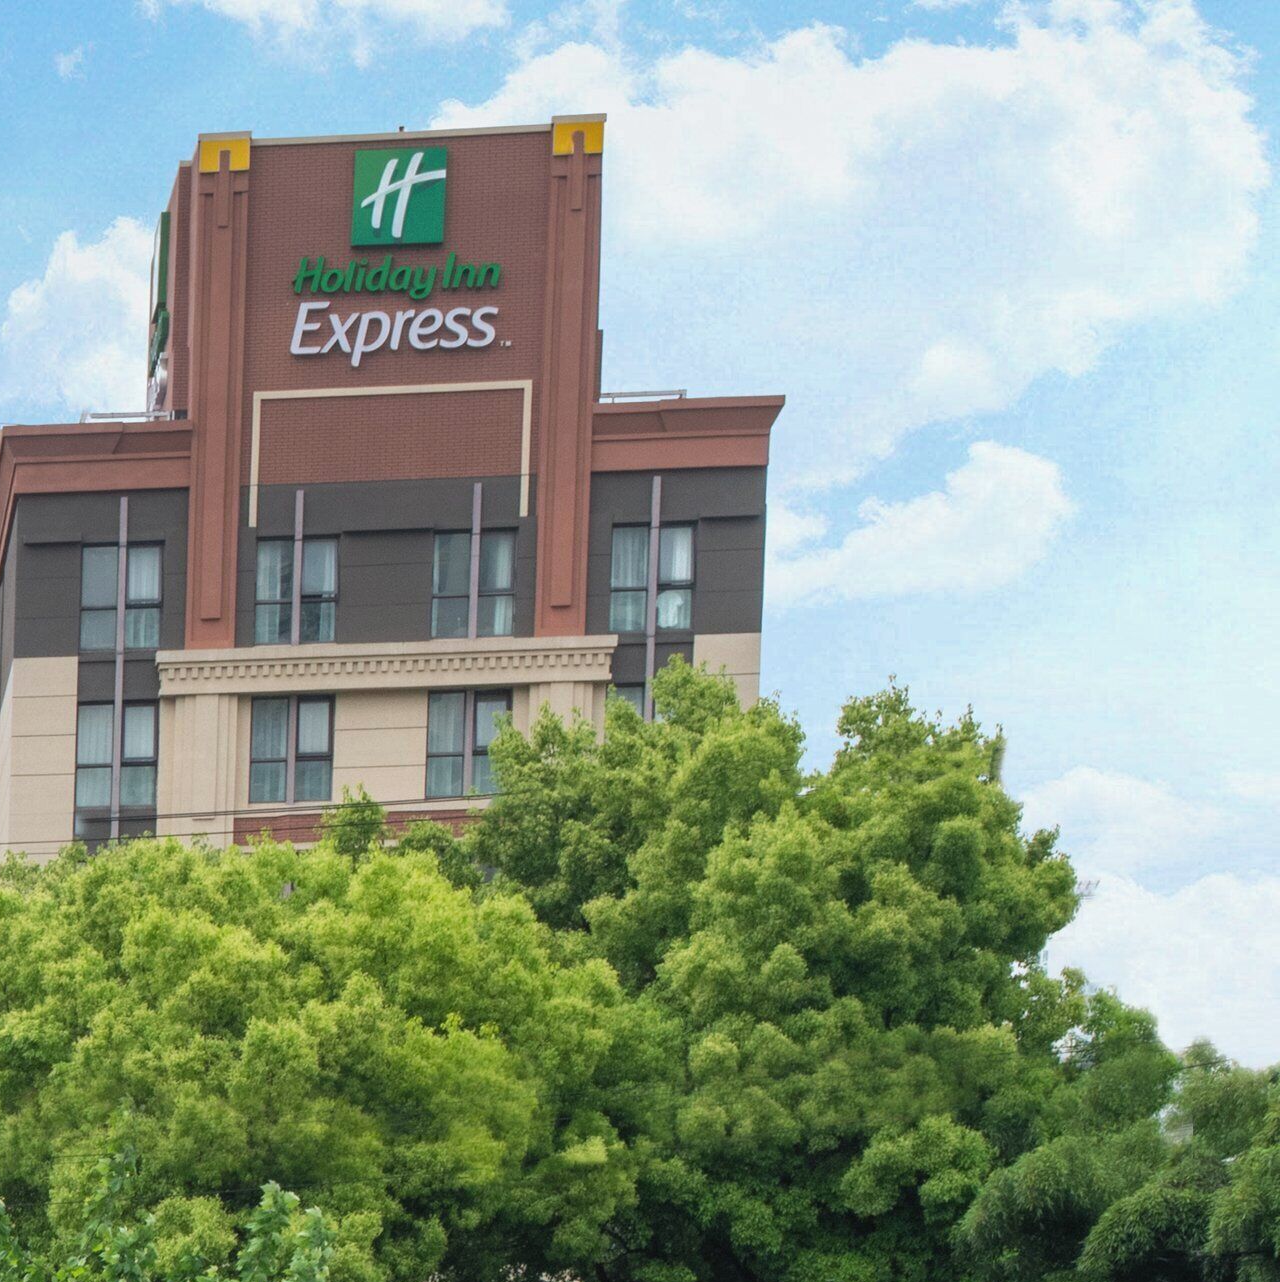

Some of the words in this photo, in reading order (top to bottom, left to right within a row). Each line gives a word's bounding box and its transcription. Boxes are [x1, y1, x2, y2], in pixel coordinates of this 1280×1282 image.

[293, 255, 437, 300] Holiday
[442, 251, 502, 290] Inn
[290, 301, 499, 368] Express
